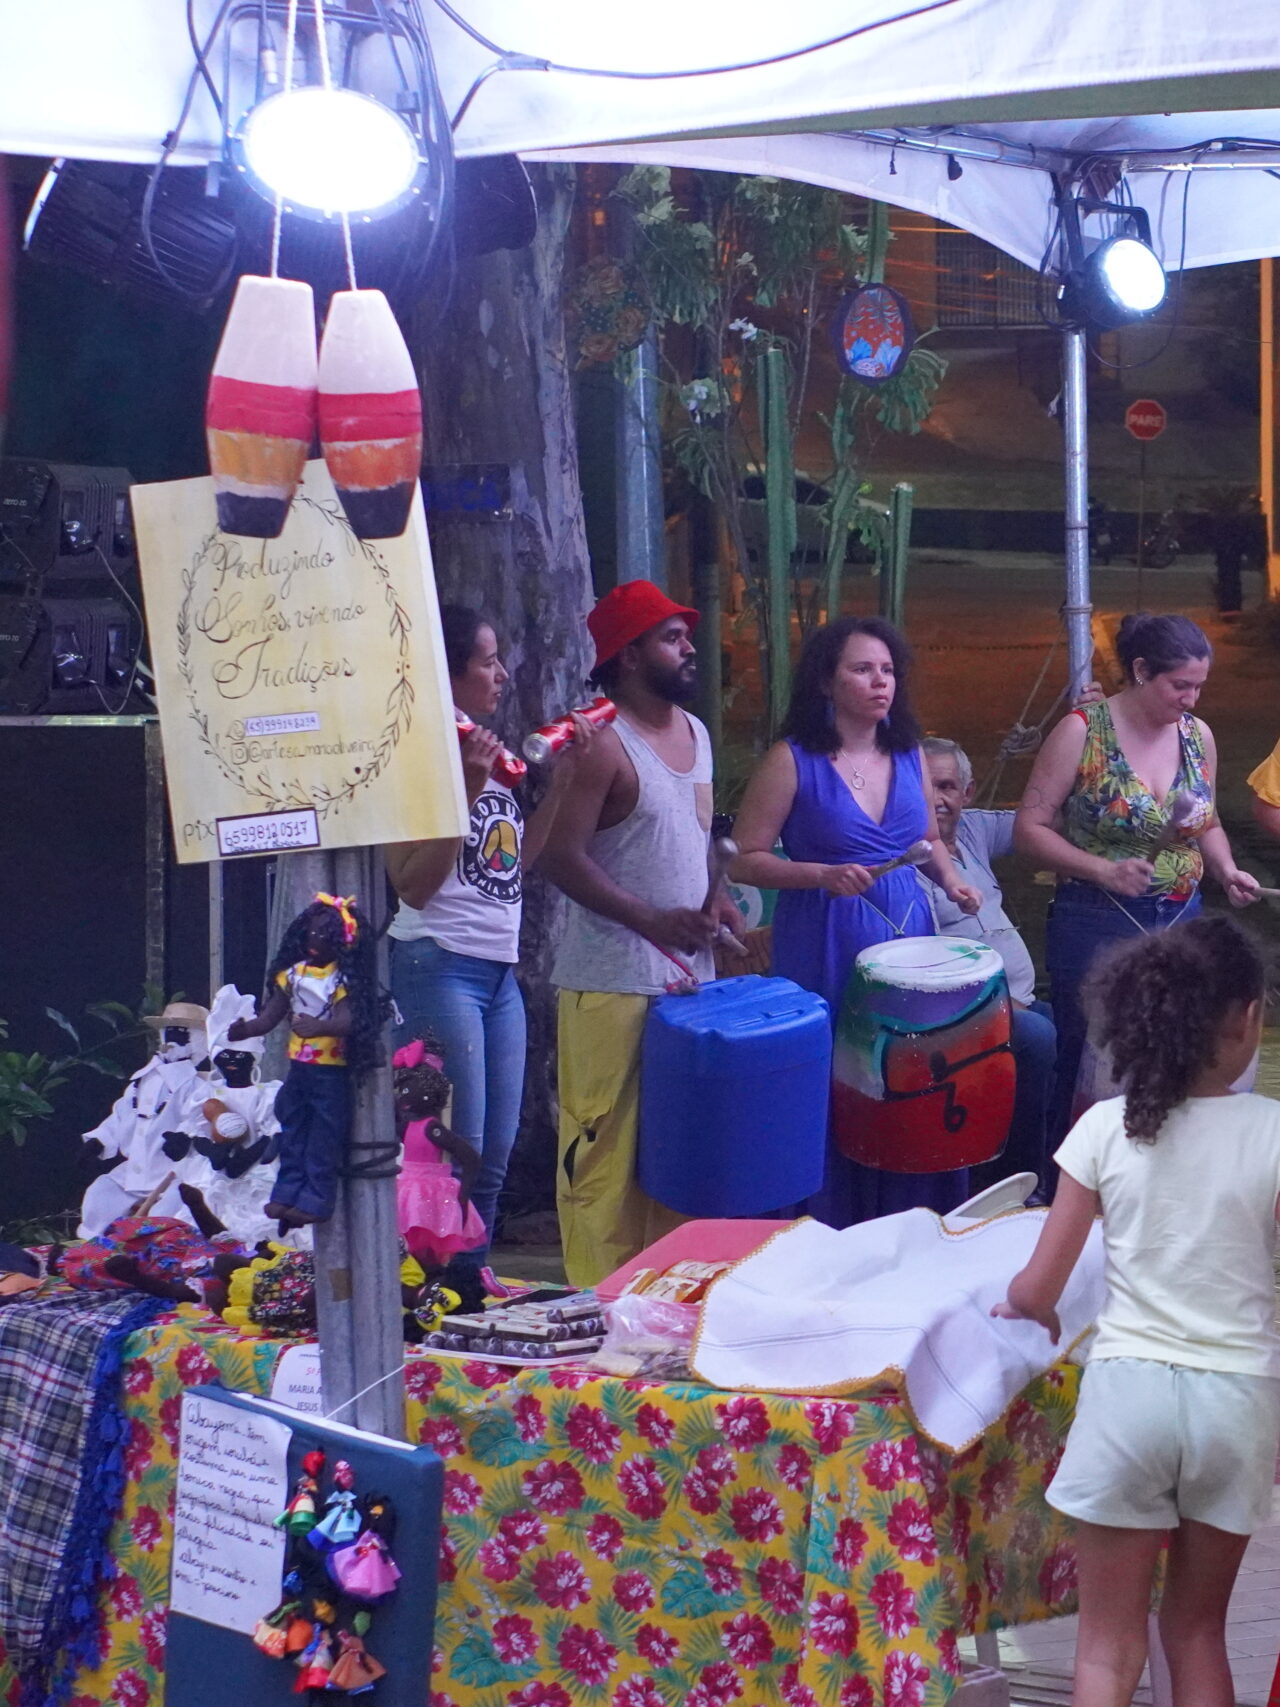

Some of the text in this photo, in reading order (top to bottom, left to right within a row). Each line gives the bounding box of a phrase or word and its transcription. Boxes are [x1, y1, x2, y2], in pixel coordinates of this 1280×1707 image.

[210, 538, 335, 600] Produzindo
[212, 633, 355, 699] Tradições
[288, 1384, 314, 1394] MARIA
